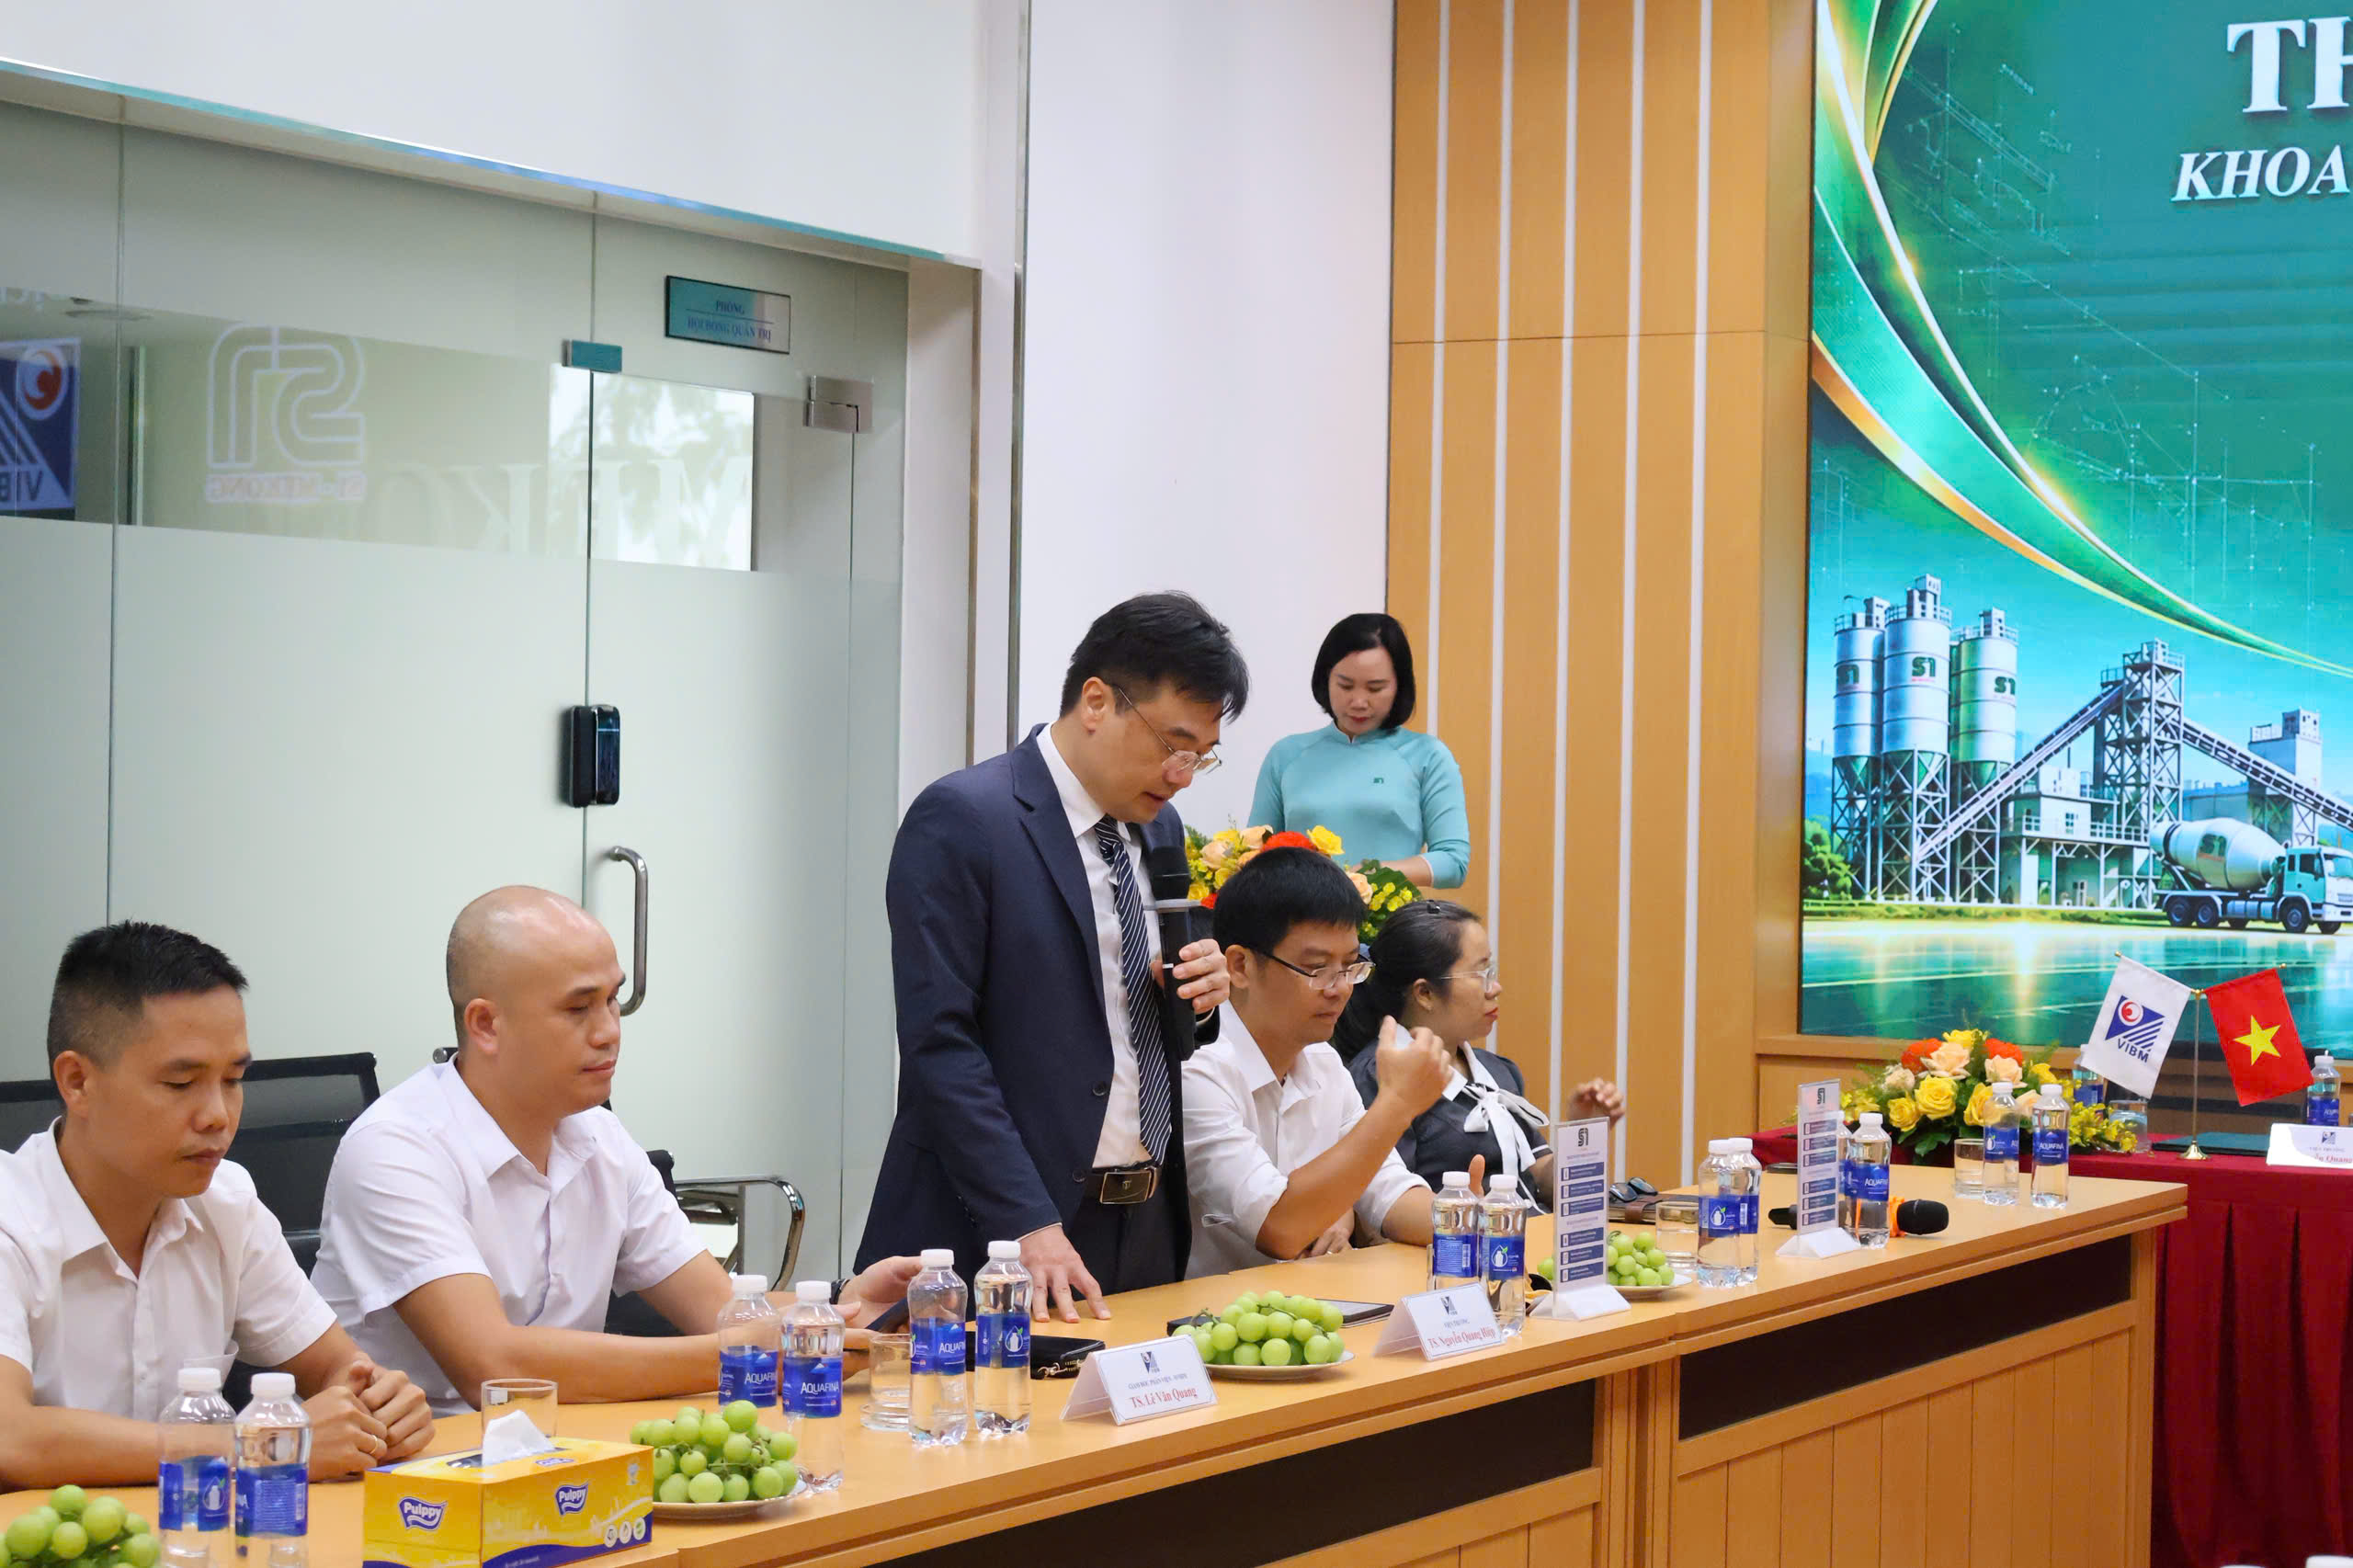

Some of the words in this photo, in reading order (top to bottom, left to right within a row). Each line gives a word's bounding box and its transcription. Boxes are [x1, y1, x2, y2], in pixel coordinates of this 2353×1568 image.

[2171, 144, 2350, 201] KHOA
[2117, 1038, 2150, 1063] VIBM
[801, 1381, 840, 1395] AQUAFINA
[1172, 1388, 1198, 1402] Quang
[558, 1488, 585, 1503] Pulppy
[404, 1501, 442, 1518] Pulppy
